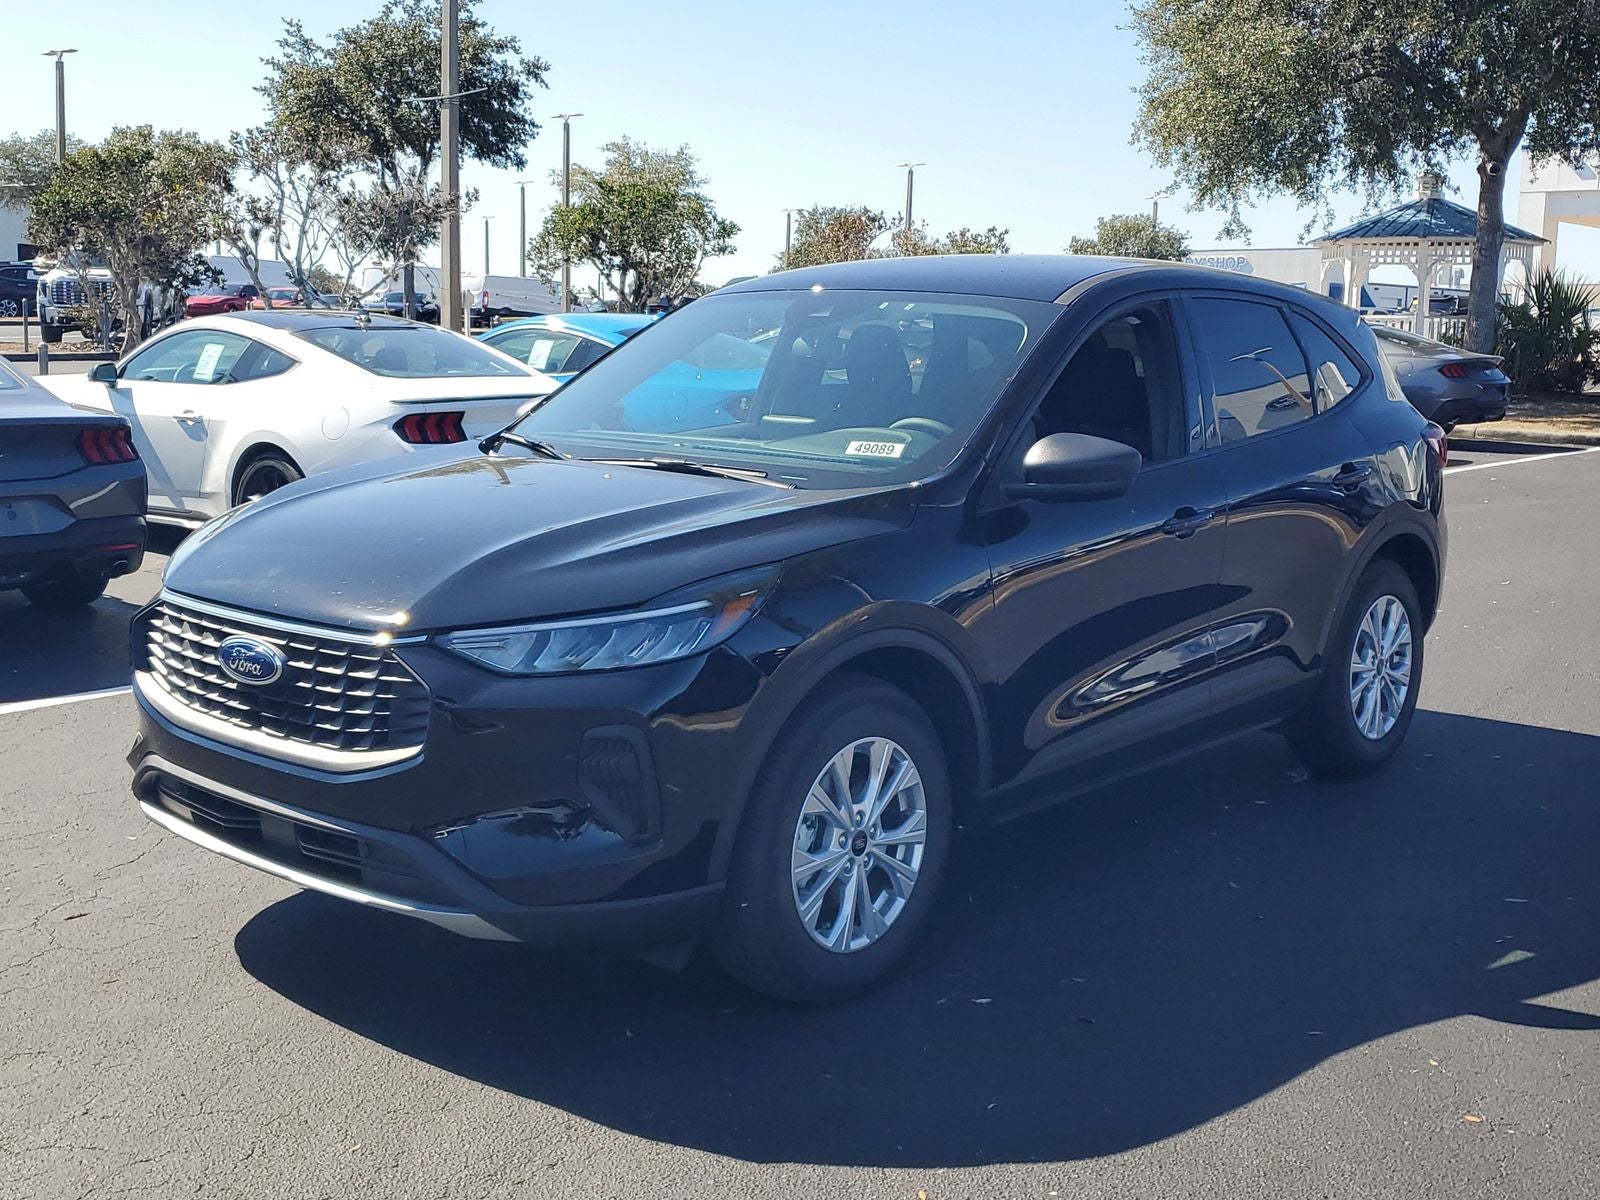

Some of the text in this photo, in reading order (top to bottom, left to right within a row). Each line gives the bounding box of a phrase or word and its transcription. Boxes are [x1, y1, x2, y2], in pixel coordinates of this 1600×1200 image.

[1207, 256, 1247, 270] SHOP
[854, 443, 895, 455] 49089
[229, 646, 263, 676] Ford
